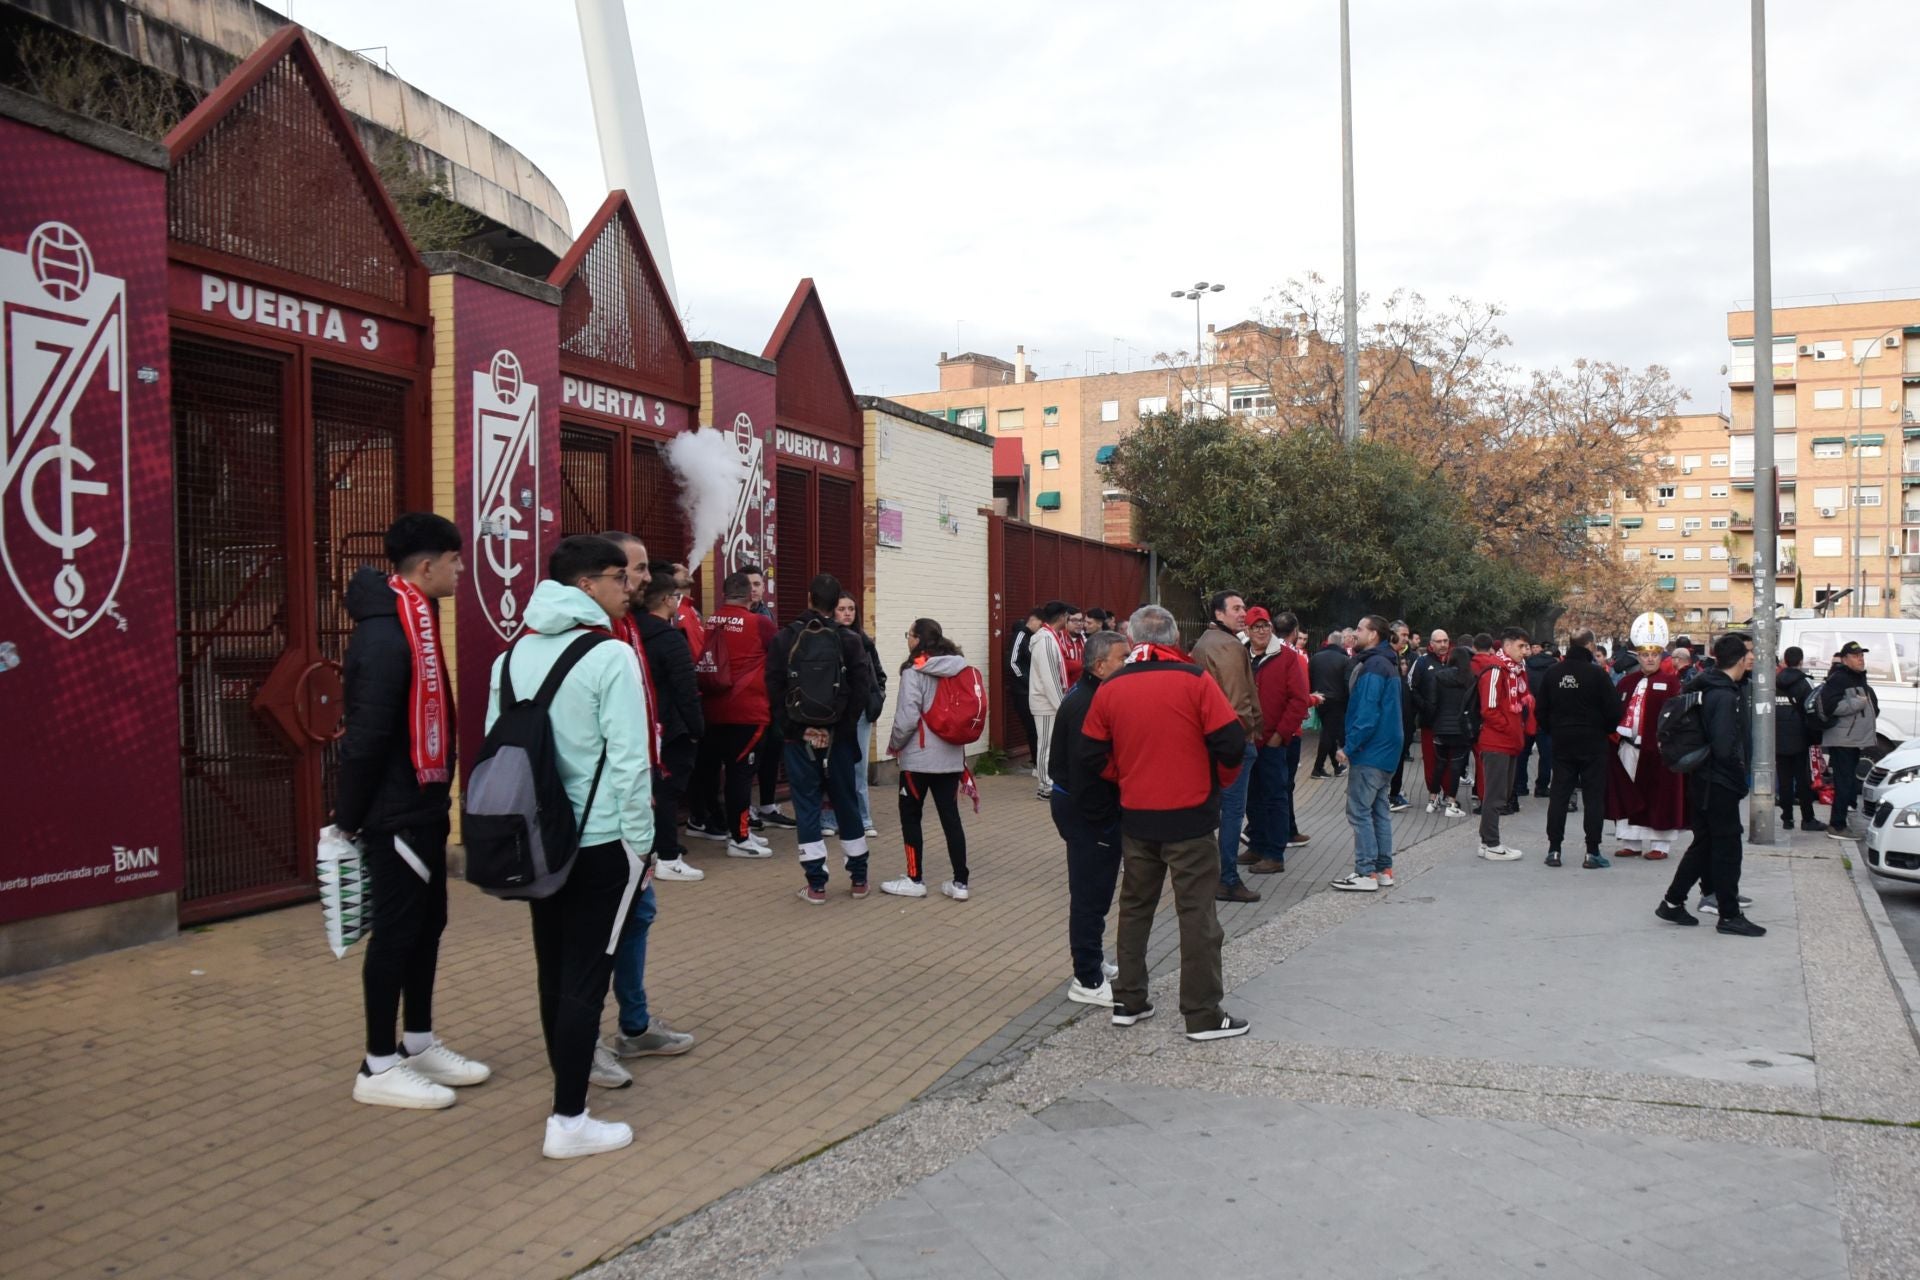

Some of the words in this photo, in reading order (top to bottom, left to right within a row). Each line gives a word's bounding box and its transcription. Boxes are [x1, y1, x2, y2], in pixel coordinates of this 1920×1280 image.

[201, 273, 348, 344] PUERTA
[360, 318, 380, 351] 3
[563, 376, 647, 422] PUERTA
[654, 401, 666, 427] 3
[775, 428, 829, 462] PUERTA
[832, 445, 841, 465] 3
[416, 603, 438, 693] GRANADA
[0, 876, 29, 892] uerta
[30, 866, 93, 889] patrocinada
[94, 863, 112, 878] por
[111, 845, 159, 872] BMN
